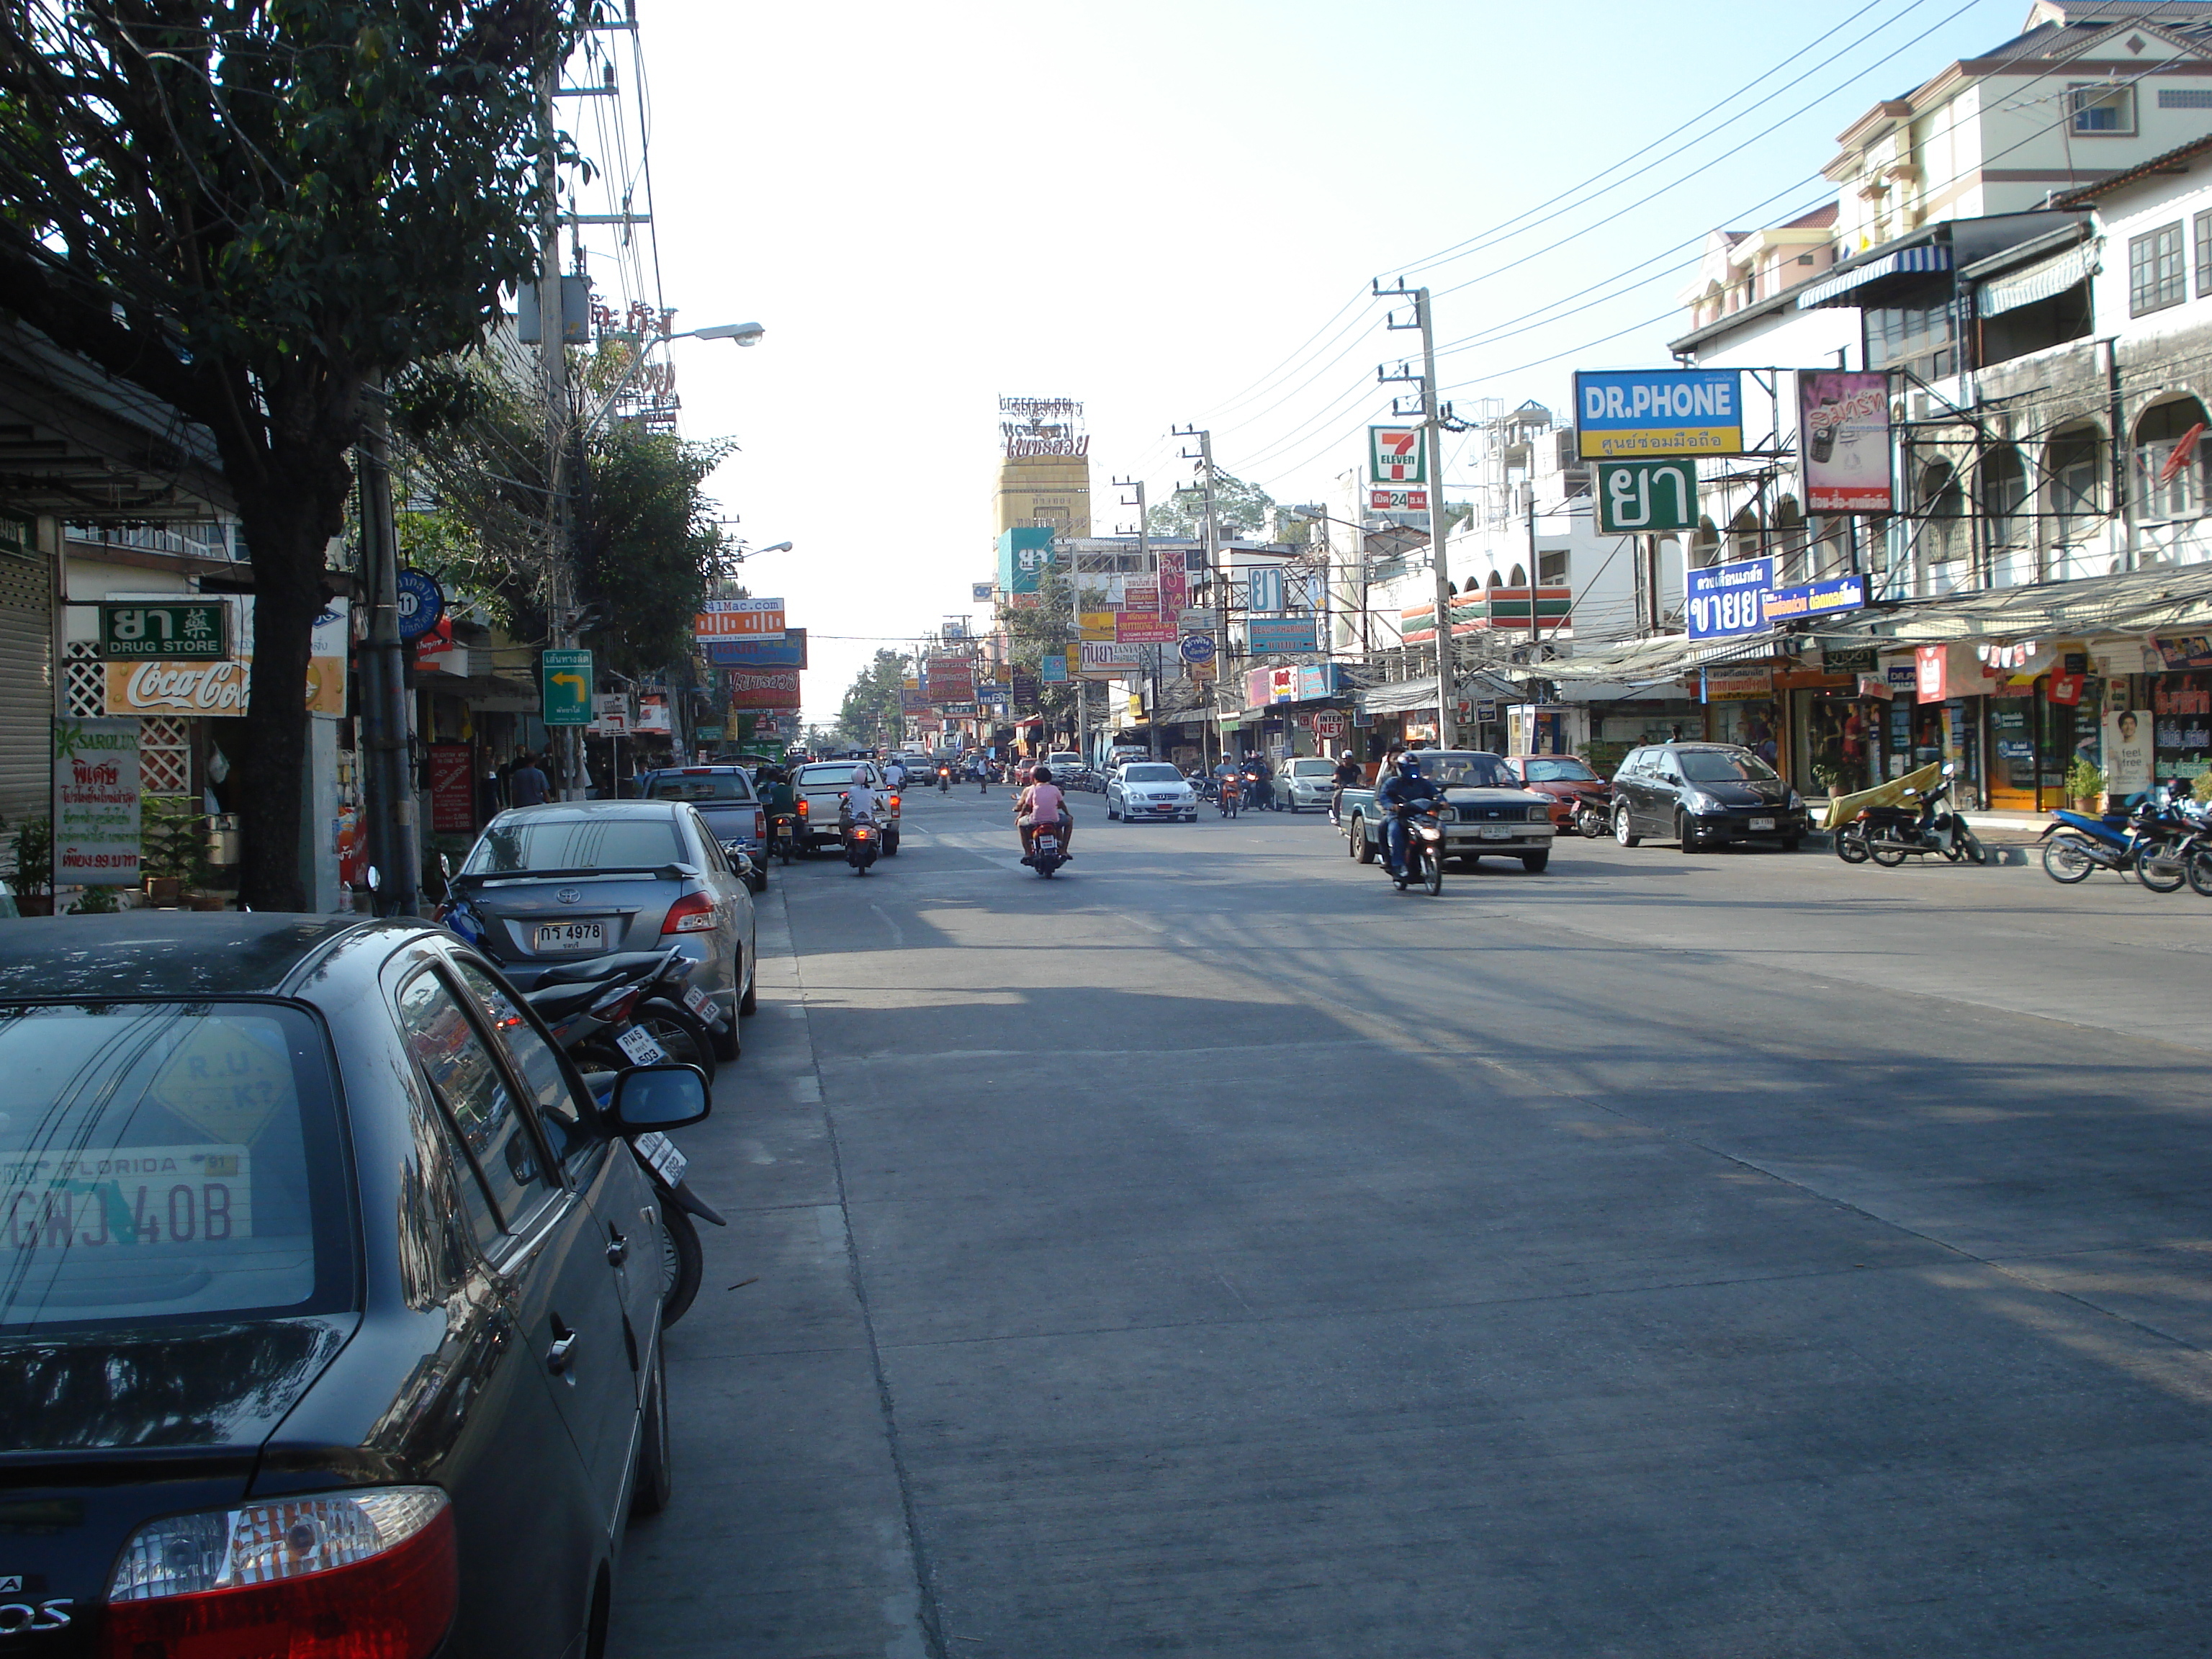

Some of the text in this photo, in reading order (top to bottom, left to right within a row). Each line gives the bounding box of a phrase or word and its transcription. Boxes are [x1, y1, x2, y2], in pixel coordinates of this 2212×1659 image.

[1585, 383, 1732, 419] DR.PHONE
[1601, 431, 1721, 455] ศูนย์ซ่อมมือถือ
[1382, 433, 1414, 479] 7
[1390, 493, 1408, 506] 24
[1609, 466, 1688, 526] ยา
[1252, 569, 1282, 611] ยา
[398, 597, 411, 611] 11
[708, 601, 779, 611] 41Mac.com
[1690, 588, 1771, 632] ขายย
[114, 609, 172, 640] ยา
[1253, 626, 1274, 634] BEACH
[110, 640, 218, 652] DRUG STORE
[546, 653, 589, 663] เส้นทางลัด
[127, 661, 251, 709] Coca-Col
[1321, 724, 1342, 733] NET
[567, 925, 600, 939] 4978
[63, 1157, 178, 1177] FLORIDA
